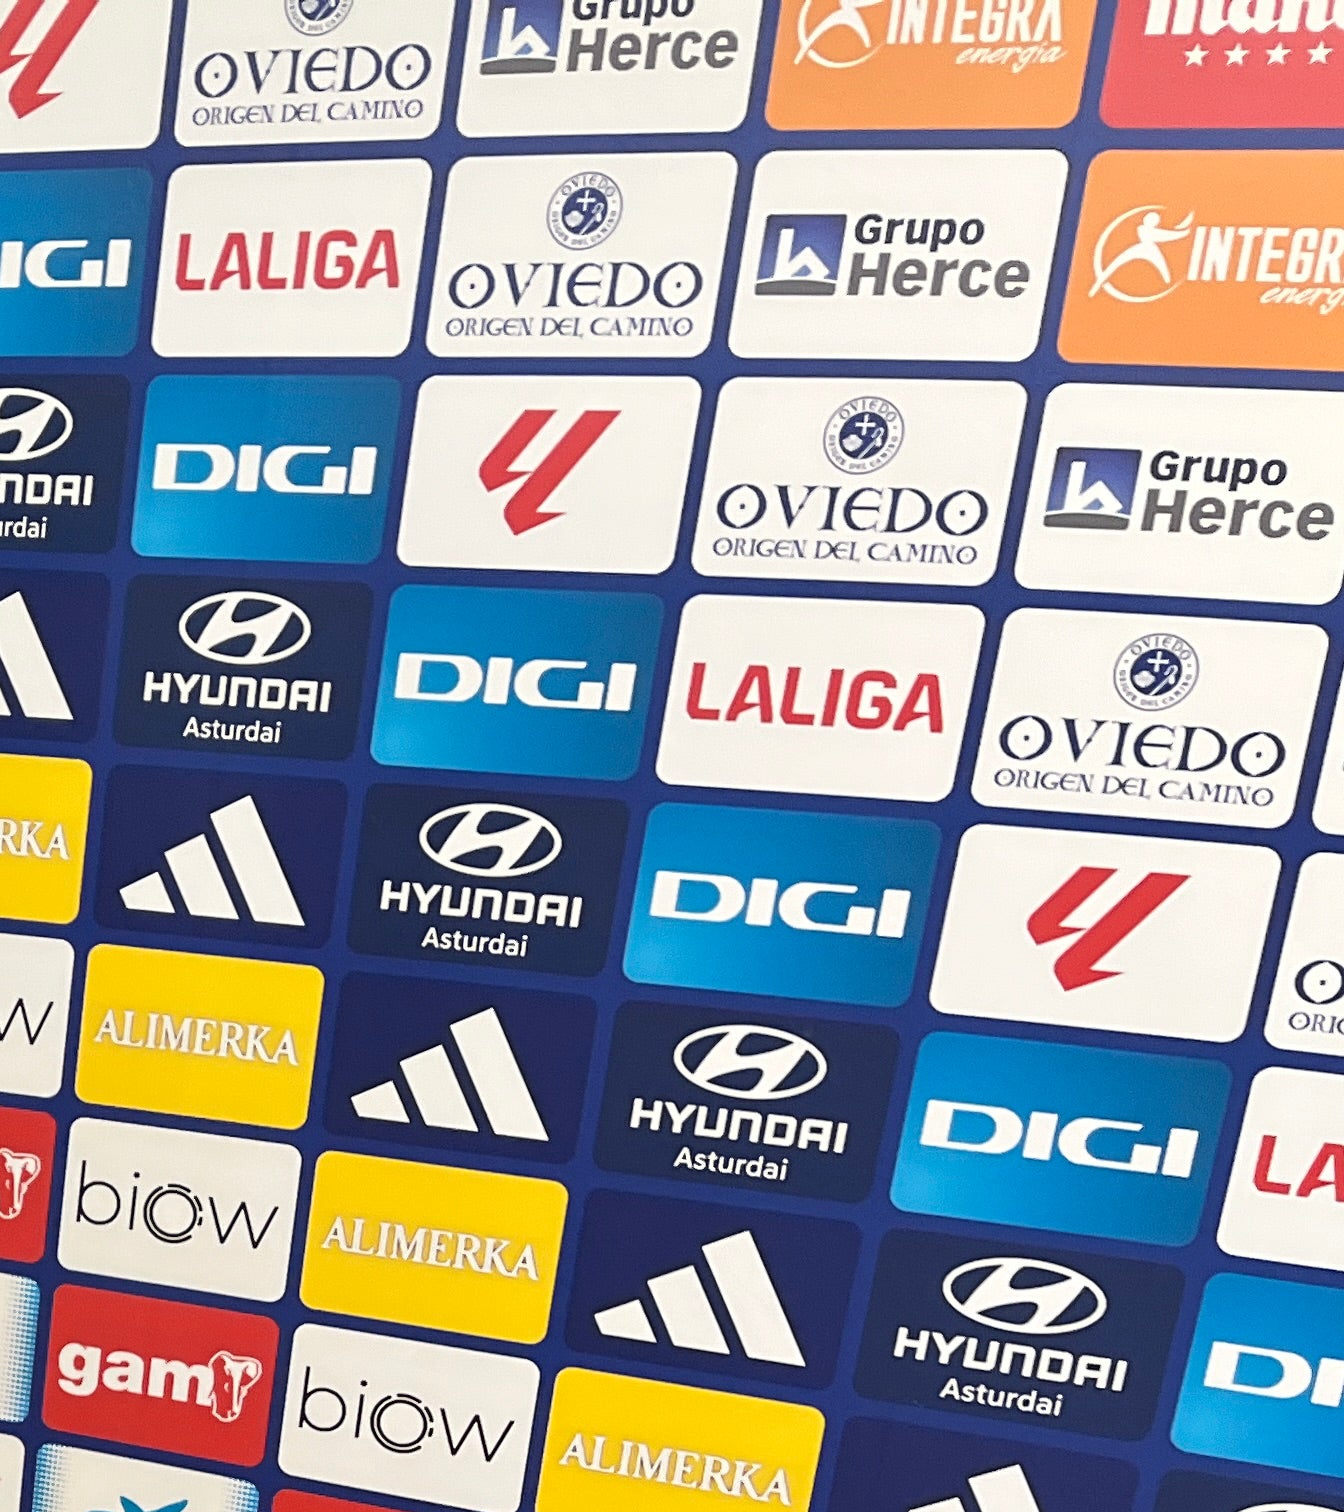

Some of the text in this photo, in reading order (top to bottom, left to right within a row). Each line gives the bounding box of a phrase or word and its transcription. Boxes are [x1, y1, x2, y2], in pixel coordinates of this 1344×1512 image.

[572, 0, 693, 25] Grupo
[887, 0, 1062, 44] INTEGRA
[194, 44, 432, 99] OVIEDO
[567, 28, 738, 72] Herce
[192, 99, 424, 127] ORIGEN DEL CAMINO
[854, 213, 984, 251] Grupo
[1187, 226, 1344, 283] INTEGR
[174, 229, 399, 291] LALIGA
[448, 261, 703, 310] OVIEDO
[846, 253, 1030, 298] Herce
[1259, 286, 1344, 315] energ
[445, 316, 693, 338] ORIGEN DEL CAMINO
[151, 443, 378, 495] DIGI
[1149, 450, 1287, 492] Grupo
[716, 484, 988, 536] OVIEDO
[1139, 488, 1335, 541] Herce
[712, 538, 978, 565] ORIGEN DEL CAMINO
[143, 671, 331, 713] HYUNDAI
[394, 652, 638, 711] DIGI
[685, 662, 944, 733] LALIGA
[183, 716, 281, 744] Asturdai
[999, 715, 1285, 778] OVIEDO
[993, 768, 1273, 807] ORIGEN DEL CAMINO
[380, 879, 582, 928] HYUNDAI
[649, 871, 912, 939] DIGI
[421, 926, 528, 957] Asturdai
[94, 1009, 300, 1067] ALIMERKA
[630, 1098, 848, 1155] HYUNDAI
[919, 1099, 1199, 1179] DIGI
[673, 1145, 788, 1182] Asturdai
[76, 1160, 279, 1250] biow
[321, 1215, 540, 1282] ALIMERKA
[57, 1341, 213, 1407] gam
[894, 1326, 1128, 1393] HYUNDAI
[1204, 1341, 1344, 1408] DI
[298, 1366, 515, 1463] biow
[939, 1376, 1063, 1417] Asturdai
[559, 1433, 792, 1507] ALIMERKA
